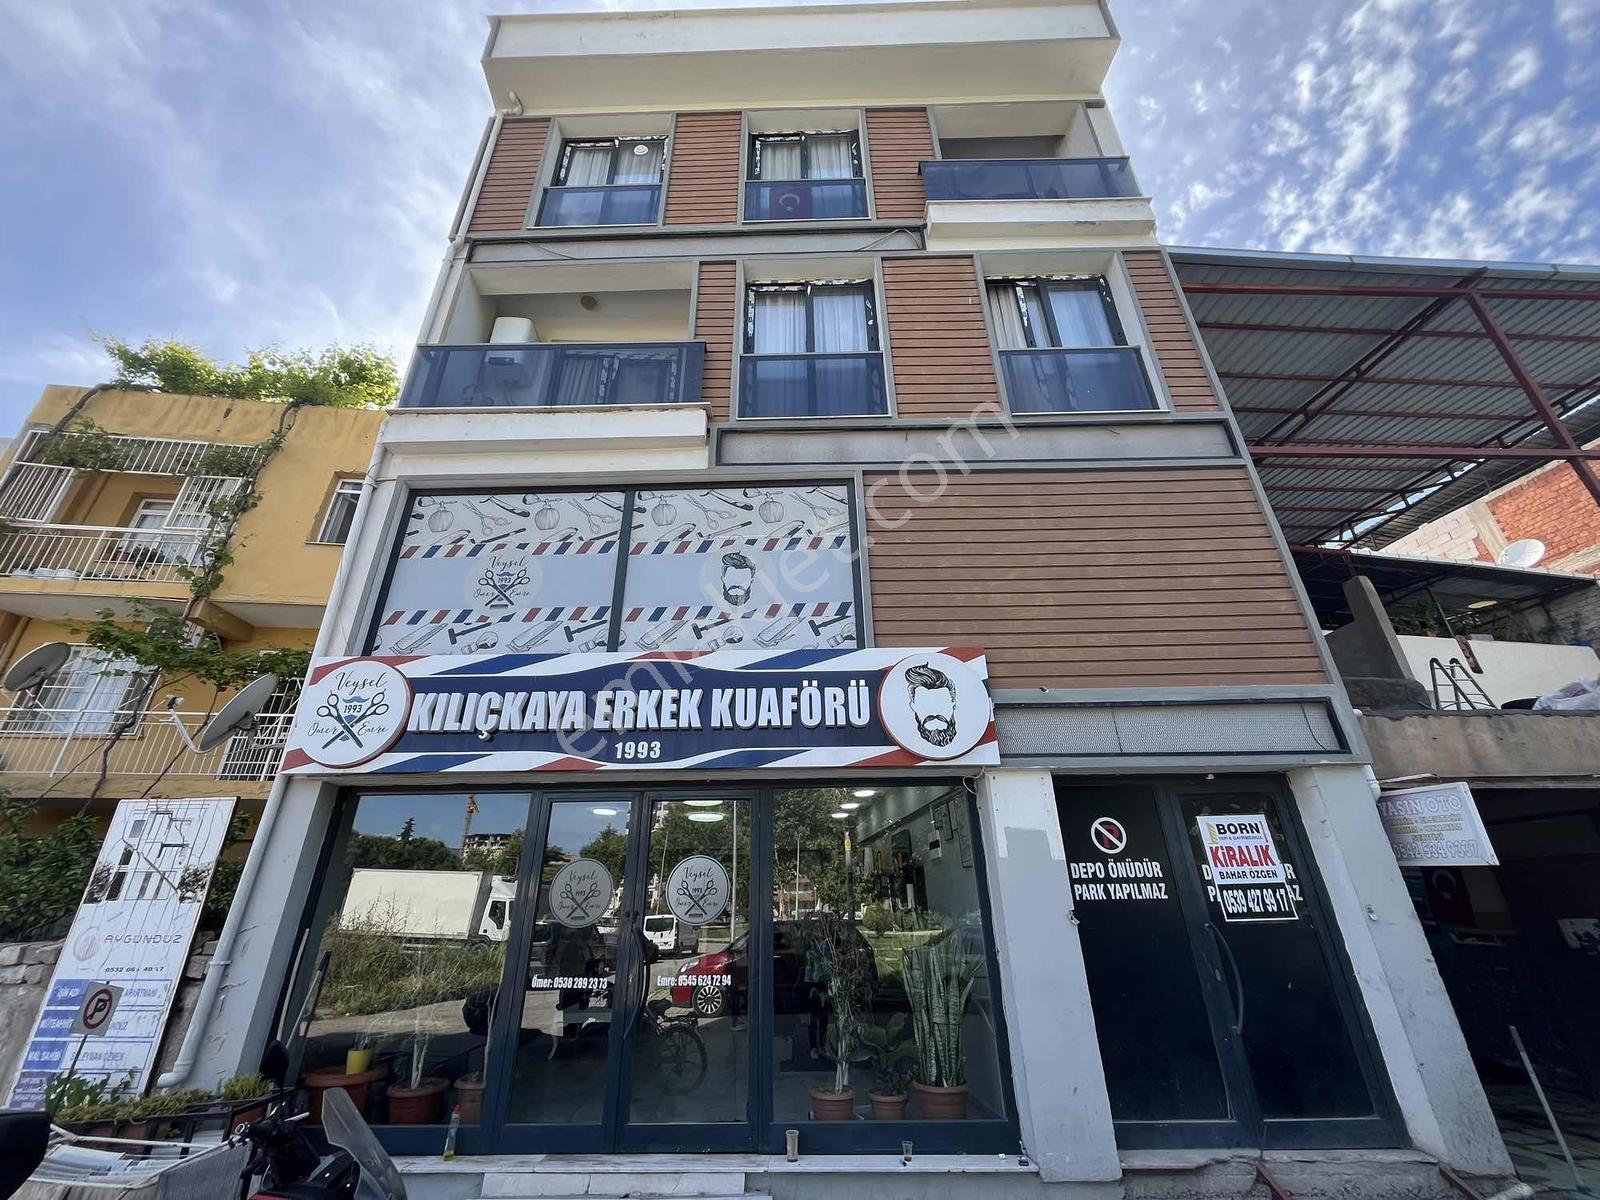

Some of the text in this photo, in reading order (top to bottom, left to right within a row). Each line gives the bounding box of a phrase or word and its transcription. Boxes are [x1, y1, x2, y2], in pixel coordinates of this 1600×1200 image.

[490, 556, 526, 571] Veysel
[336, 671, 388, 696] Veysel
[344, 705, 362, 713] 1993
[407, 679, 872, 742] KILIÇKAYA ERKEK KUAFÖRÜ
[358, 721, 388, 736] Emre
[615, 741, 662, 759] 1993
[1425, 795, 1462, 813] OTO
[1215, 823, 1261, 835] BORN
[1070, 858, 1163, 879] DEPO ÖNÜDÜR
[1219, 871, 1248, 880] BAHAR
[1249, 868, 1278, 879] ÖZGEN
[1073, 883, 1169, 901] PARK YAPILMAZ
[1223, 889, 1247, 913] 0539
[1247, 889, 1264, 913] 427
[1263, 888, 1277, 912] 99
[1276, 889, 1289, 912] 17
[531, 974, 608, 989] Ömer: 0538 289 23 73
[657, 975, 677, 986] Emre:
[697, 975, 712, 986] 624
[712, 975, 721, 986] 72
[721, 974, 732, 986] 94
